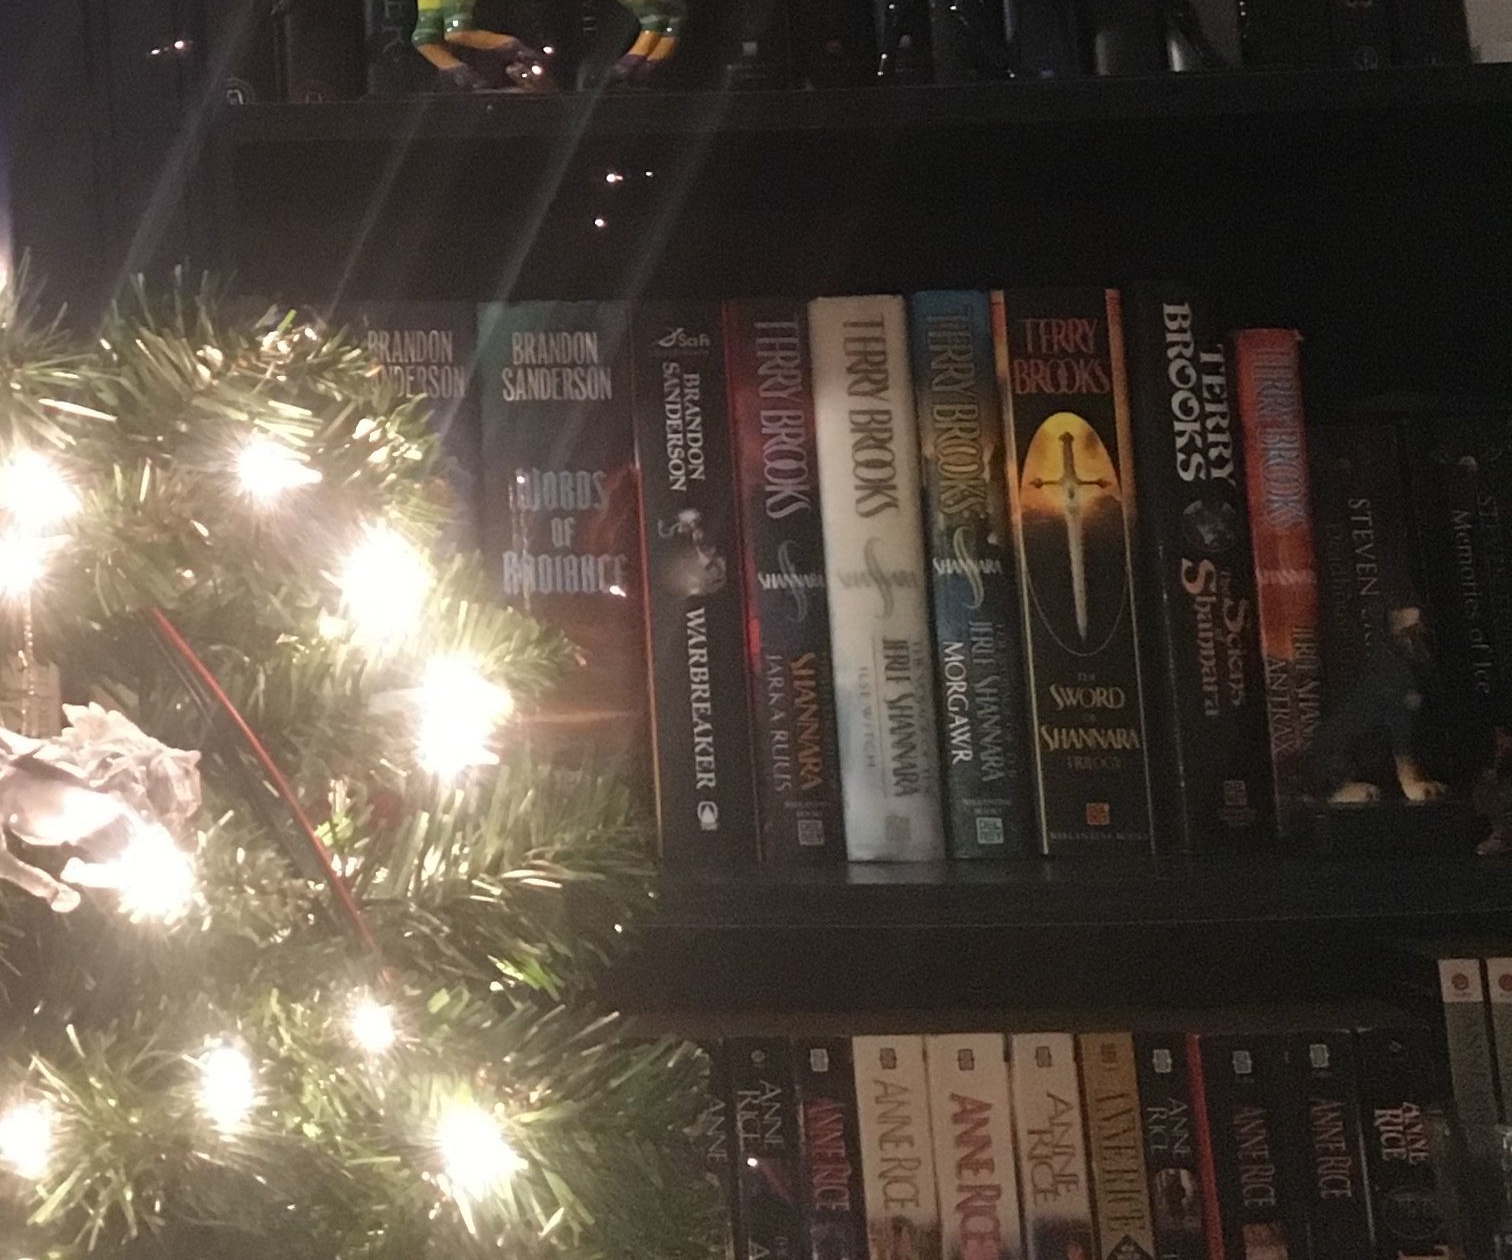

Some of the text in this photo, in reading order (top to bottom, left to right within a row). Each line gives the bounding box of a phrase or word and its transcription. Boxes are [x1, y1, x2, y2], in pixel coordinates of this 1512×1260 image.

[367, 330, 453, 363] BRANDON
[501, 366, 612, 402] SANDERSON
[511, 331, 598, 365] BRANDON
[1012, 358, 1112, 394] BROOKS
[1021, 318, 1097, 354] TERRY
[662, 361, 688, 492] SANDERSON
[681, 372, 705, 481] BRANDON
[753, 316, 812, 520] TERRY BROOKS
[844, 312, 899, 520] TERRY BROOKS
[926, 305, 983, 519] TERRY BROOKS
[1162, 302, 1205, 483] BROOKS
[1200, 344, 1235, 487] TERRY
[551, 517, 575, 548] OF
[1347, 497, 1380, 597] STEVEN
[1450, 508, 1479, 621] Memories
[1473, 660, 1494, 695] Ice
[685, 606, 719, 790] WARBREAKER
[765, 653, 793, 793] JARKA RUUS
[790, 652, 824, 791] SHANNARA
[884, 692, 920, 798] SHANNARA
[943, 641, 973, 766] MORGAWR
[974, 674, 1006, 782] SHANNARA
[1040, 724, 1141, 752] SHANNARA
[1049, 683, 1125, 711] SWORD
[1267, 657, 1294, 754] ANTRAX
[758, 1079, 785, 1151] ANNE
[872, 1079, 922, 1210] ANNE RICE
[1026, 1126, 1060, 1205] RICE
[1045, 1091, 1080, 1194] ANNE
[1167, 1096, 1191, 1159] ANNE
[1309, 1096, 1353, 1200] ANNE RICE
[1374, 1108, 1407, 1162] RICE
[1400, 1101, 1430, 1165] ANNE
[950, 1092, 1003, 1247] ANNE RICE
[1239, 1162, 1277, 1208] RICE
